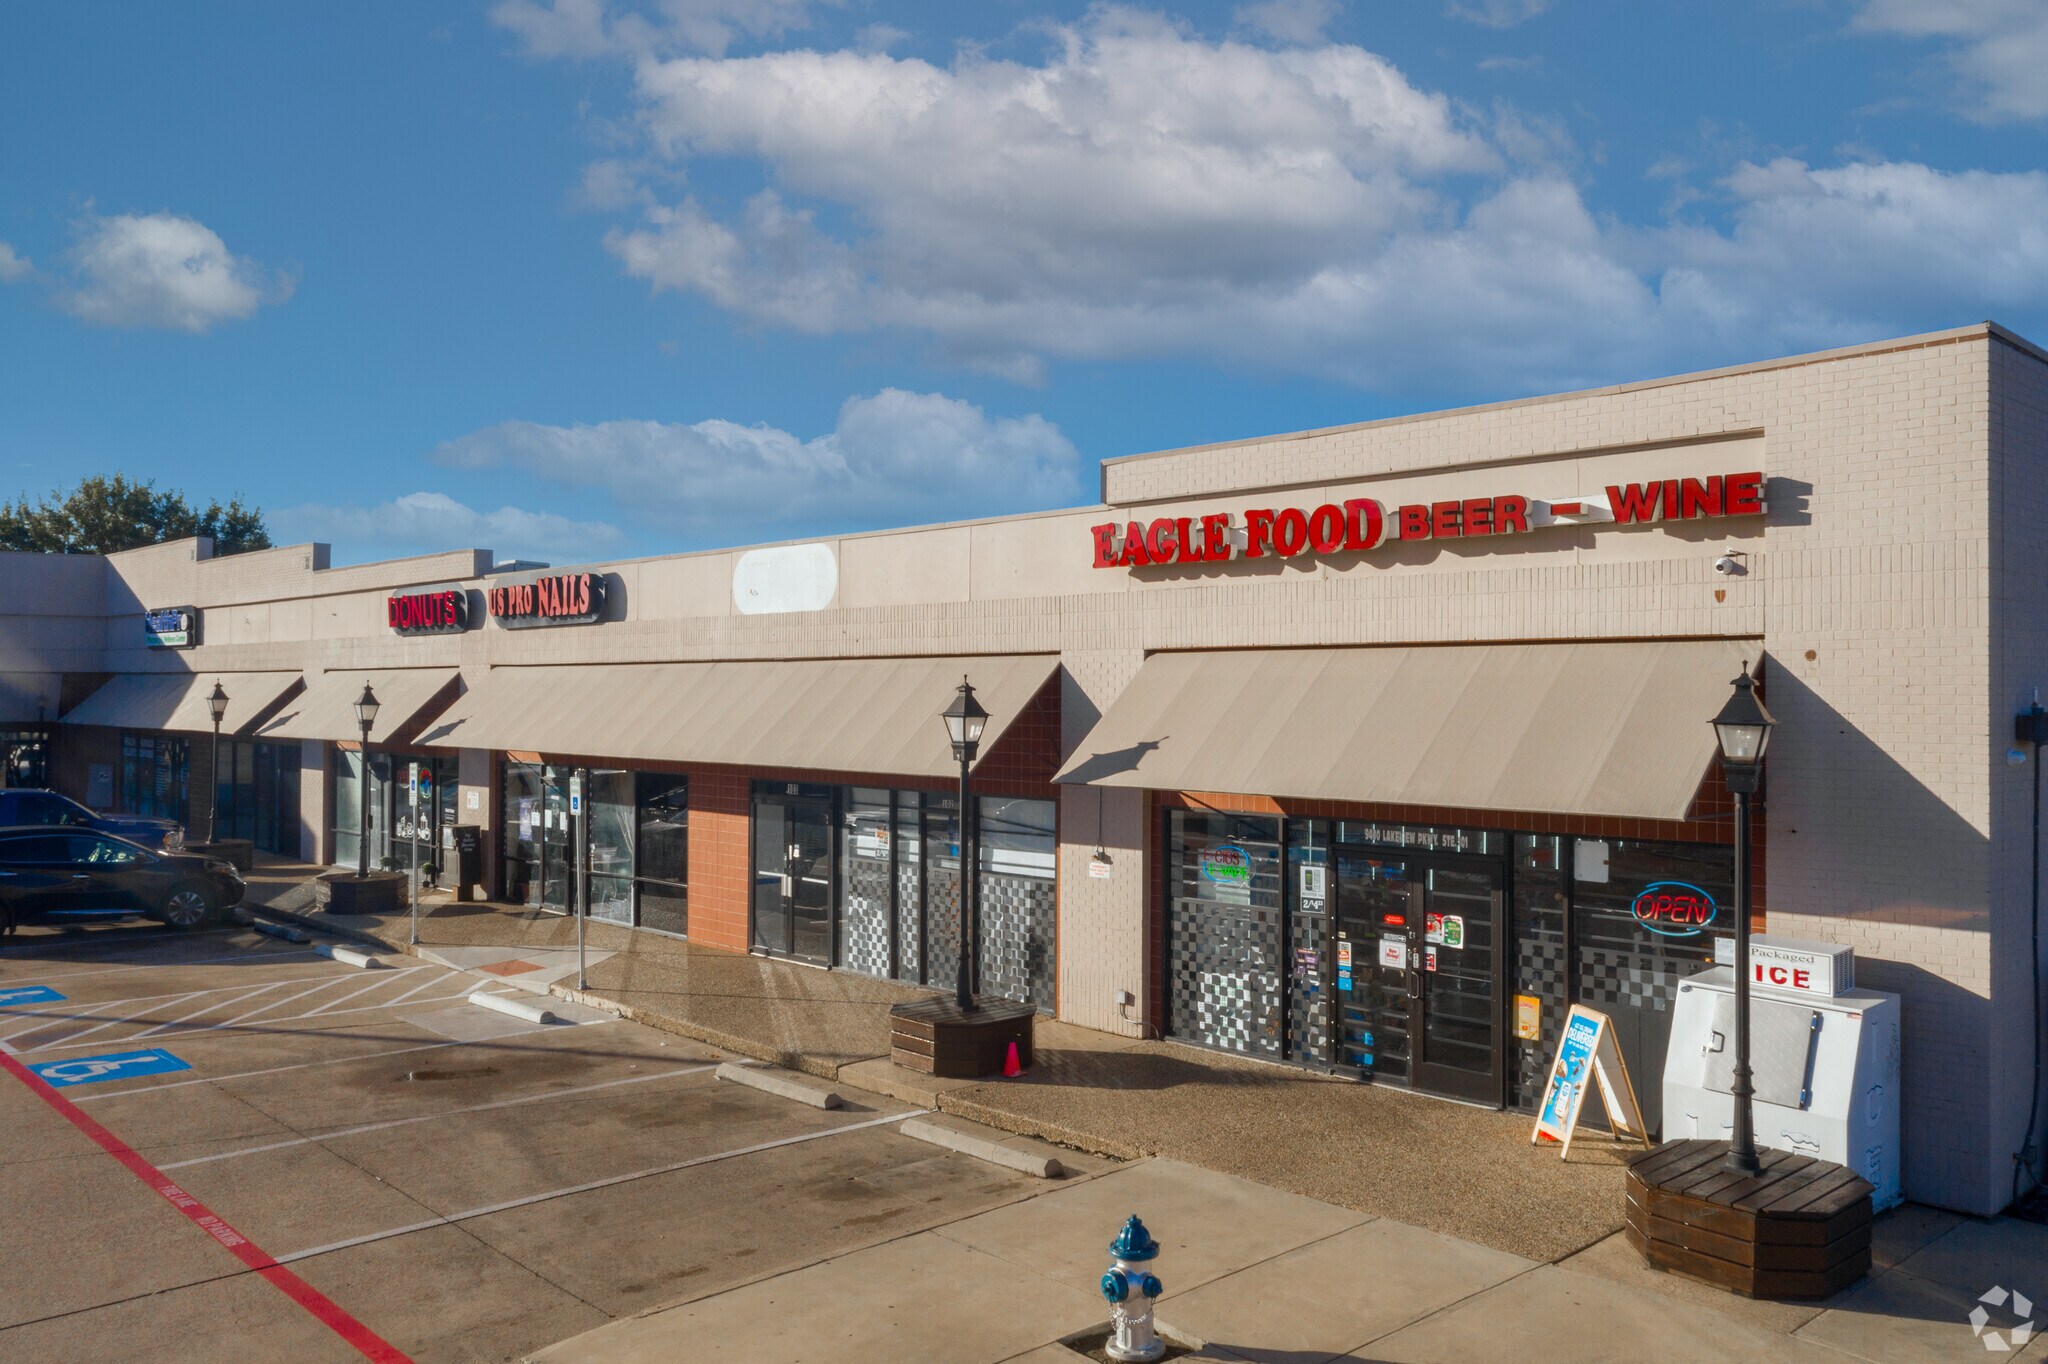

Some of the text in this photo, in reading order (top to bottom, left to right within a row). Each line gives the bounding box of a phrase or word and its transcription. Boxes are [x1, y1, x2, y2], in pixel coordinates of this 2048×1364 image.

[1090, 512, 1231, 568] EAGLE
[1244, 498, 1383, 558] FOOD
[1399, 494, 1529, 541] BEER
[1605, 472, 1763, 524] WINE
[488, 572, 590, 618] US PRO NAILS
[388, 590, 457, 628] DONUTS
[942, 799, 954, 809] 102
[1364, 828, 1380, 841] 9400
[1635, 895, 1709, 924] OPEN
[1751, 947, 1815, 964] Packaged
[1755, 963, 1810, 989] ICE
[1567, 1027, 1595, 1049] DELIVERED
